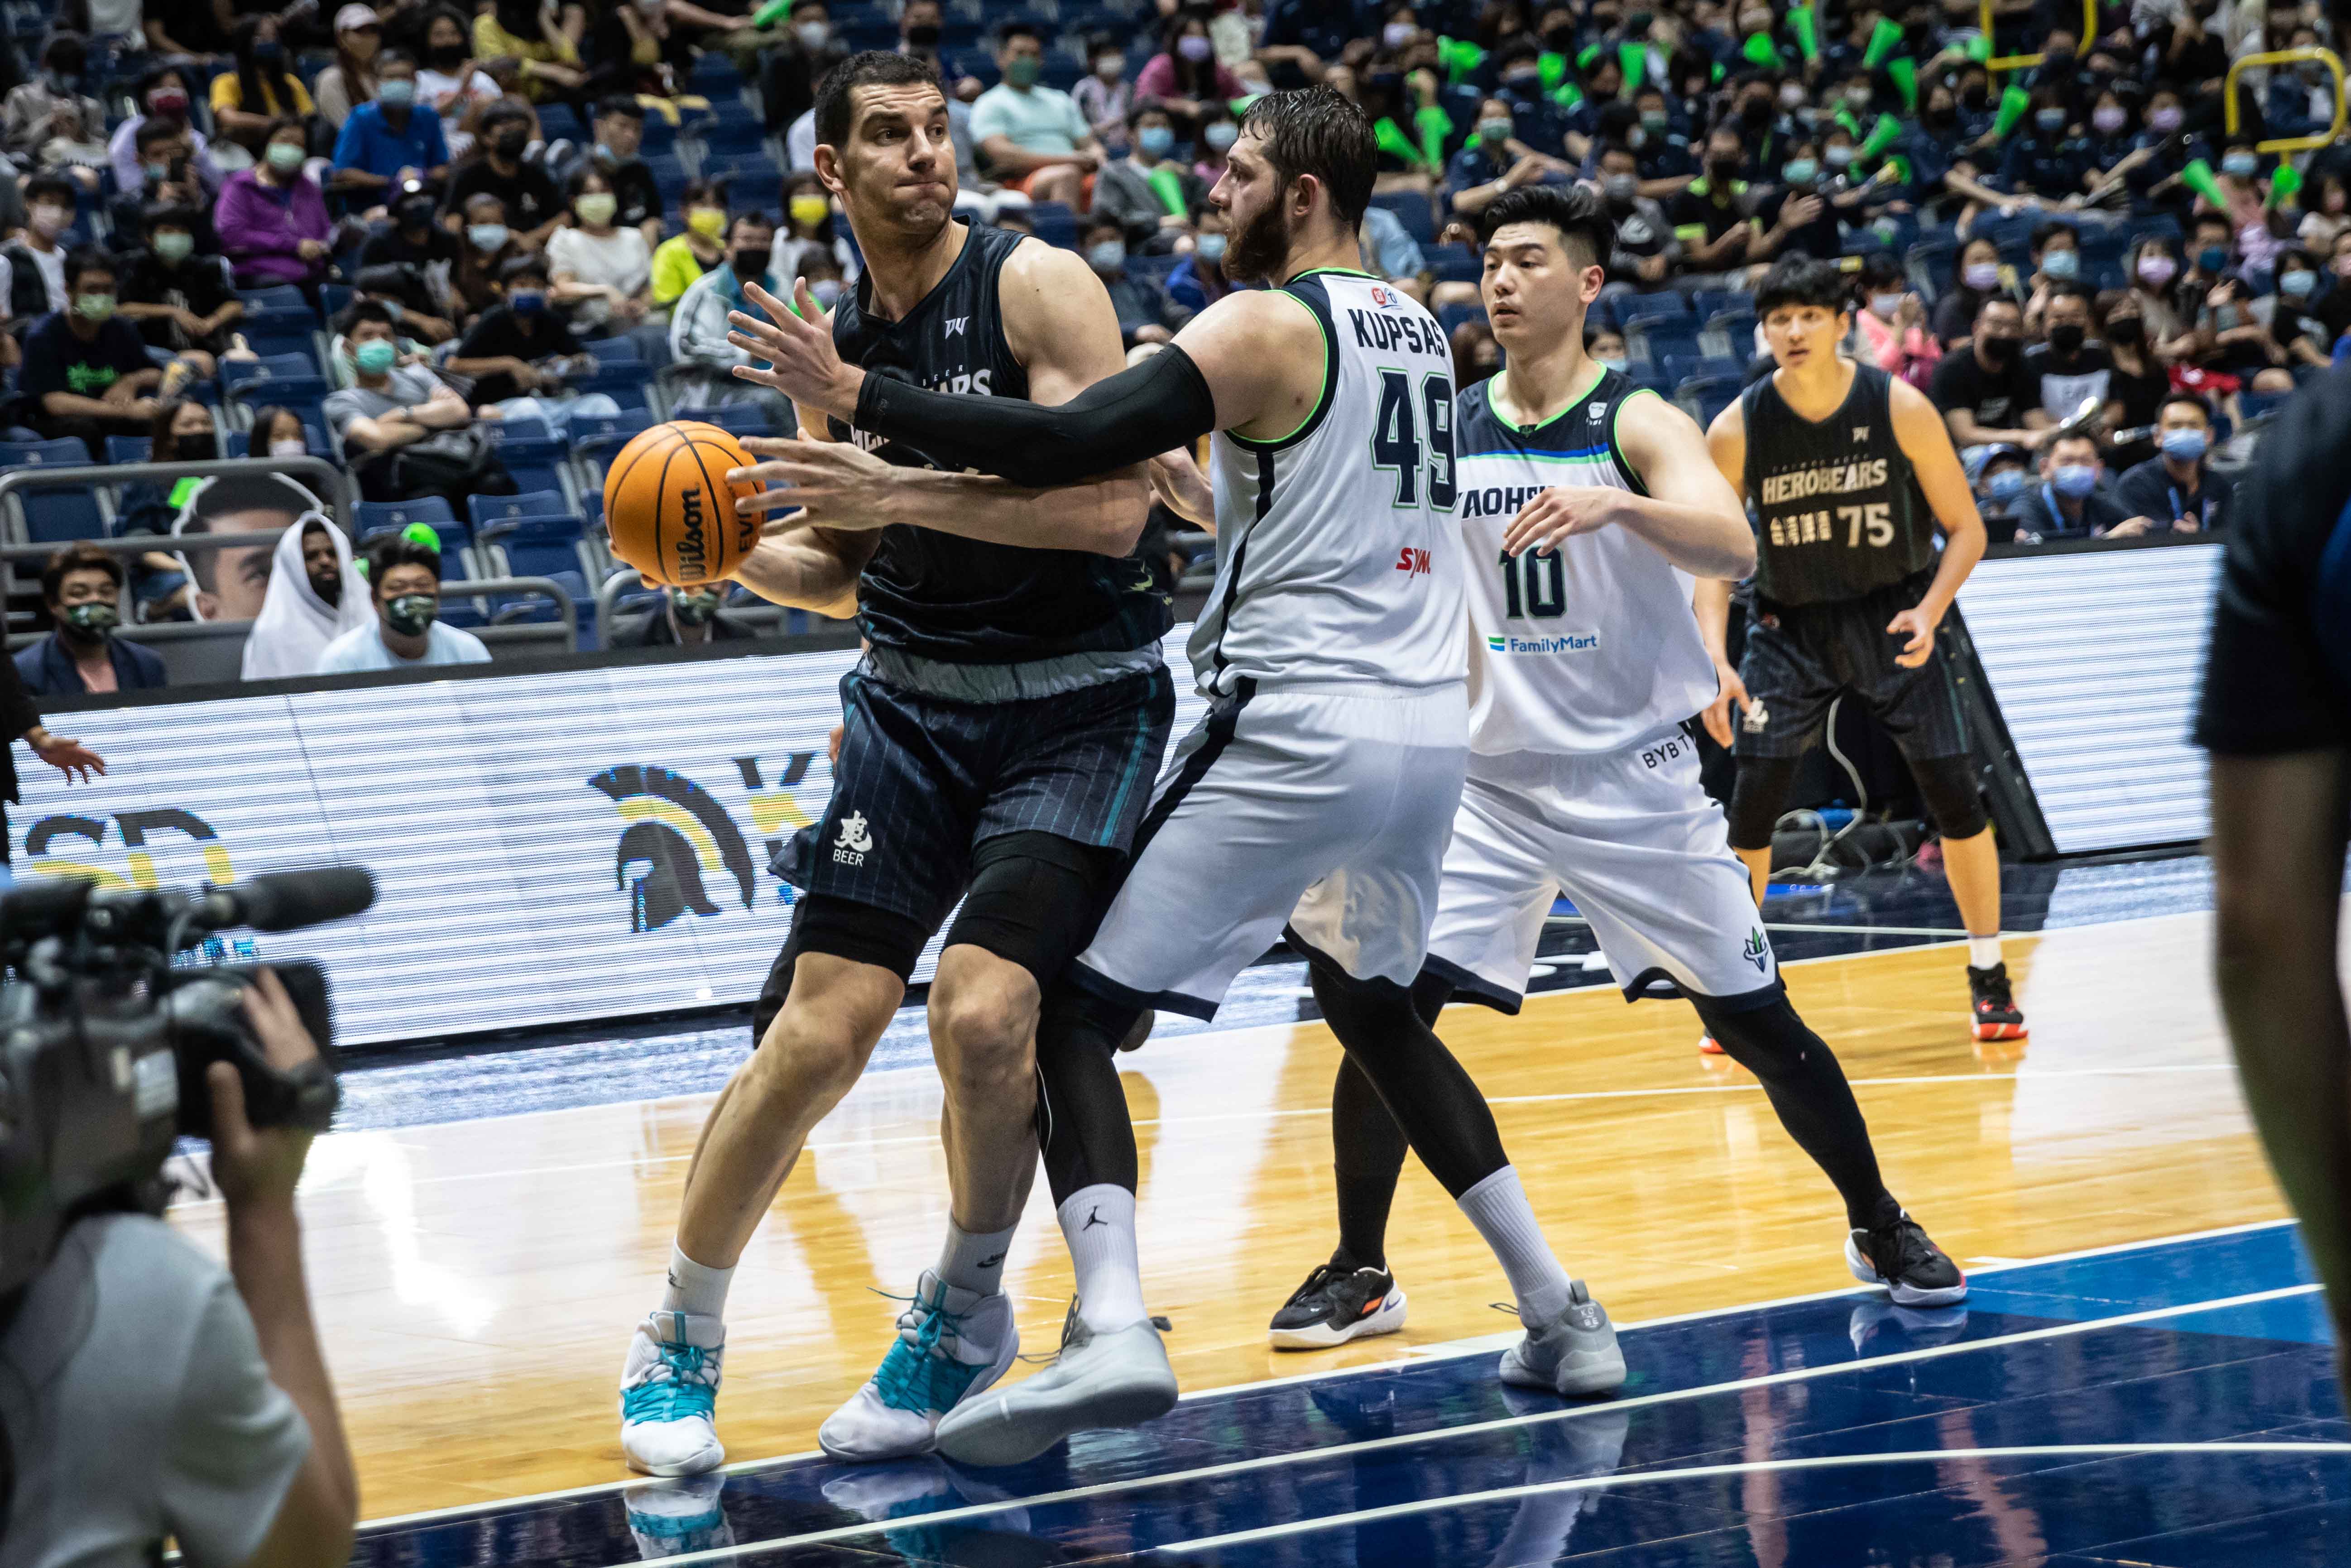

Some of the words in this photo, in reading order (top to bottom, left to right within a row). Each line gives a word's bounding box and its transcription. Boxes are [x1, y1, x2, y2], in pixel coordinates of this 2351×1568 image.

[1347, 309, 1445, 358] KUPSAS
[1369, 366, 1458, 513] 49
[1762, 458, 1888, 505] HEROBEARS
[676, 488, 707, 580] Wilson
[1836, 501, 1895, 548] 75
[1396, 547, 1431, 578] SYM
[1498, 545, 1568, 619] 10
[1510, 635, 1597, 653] FamilyMart
[833, 849, 864, 867] BEER
